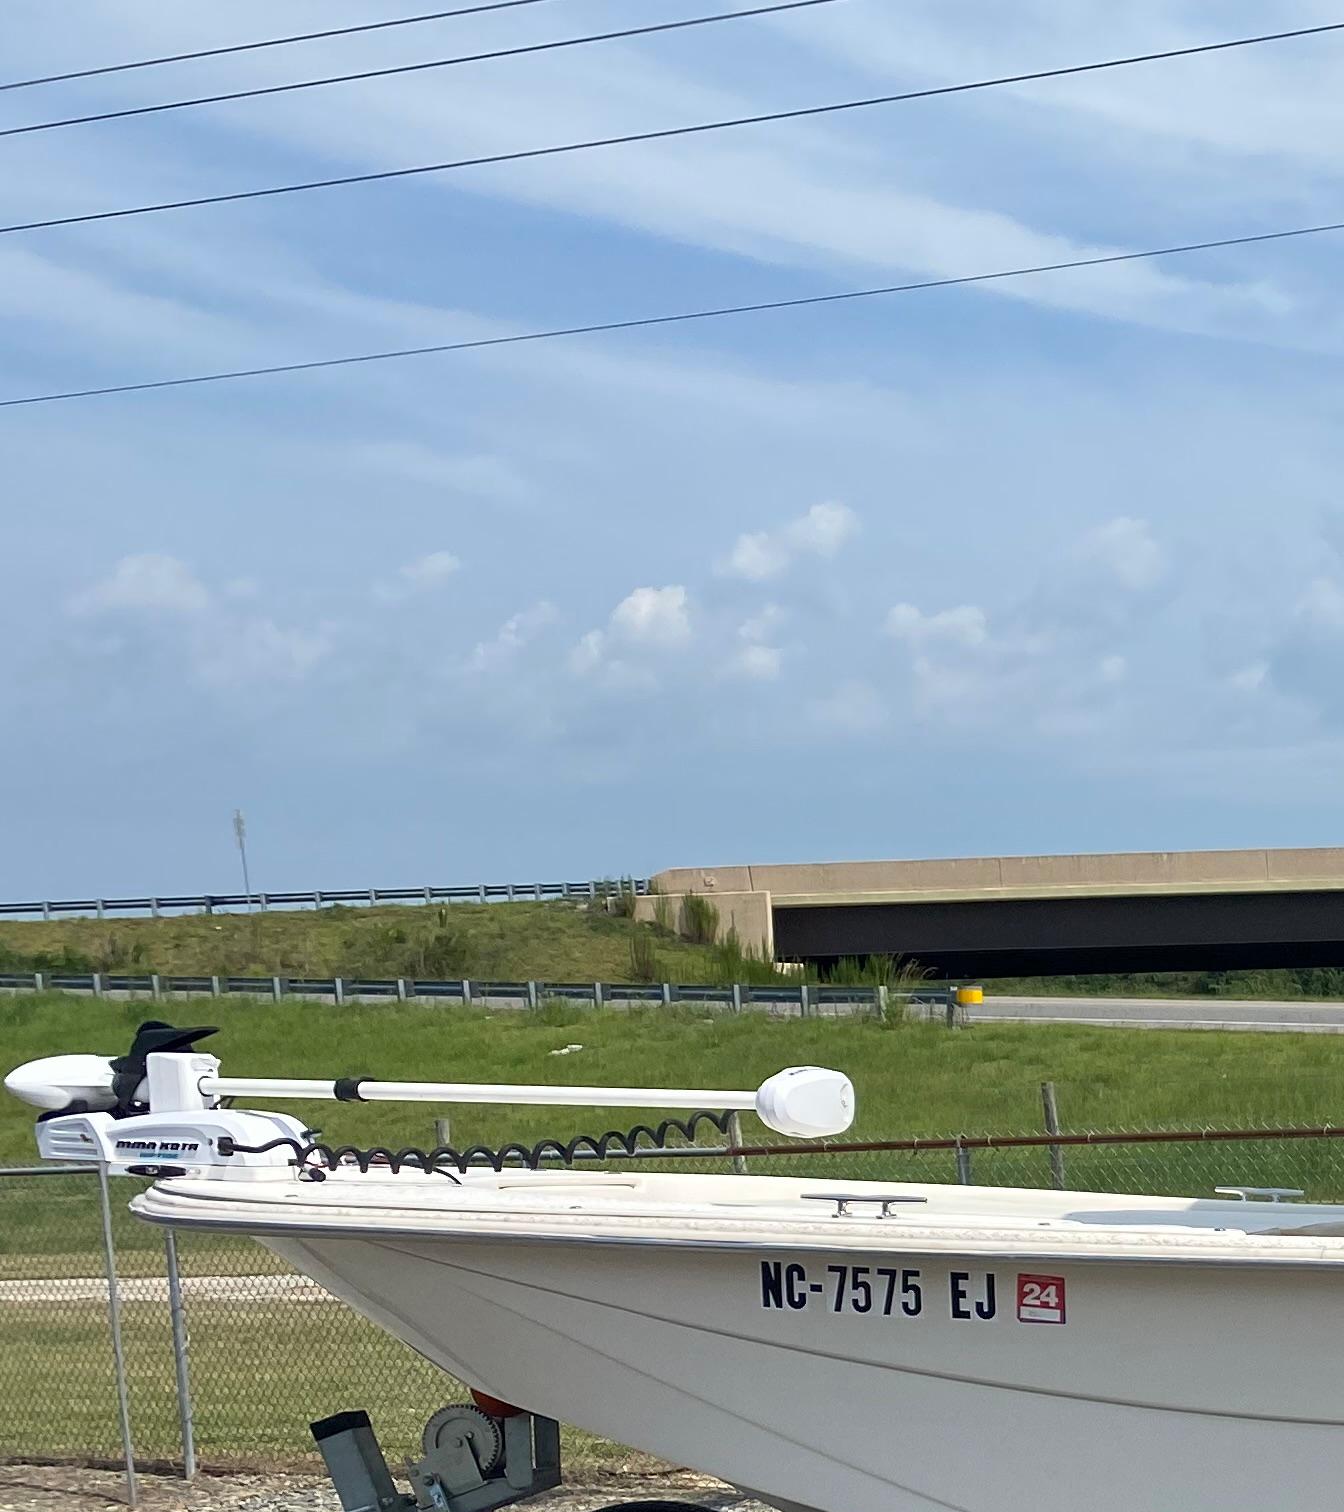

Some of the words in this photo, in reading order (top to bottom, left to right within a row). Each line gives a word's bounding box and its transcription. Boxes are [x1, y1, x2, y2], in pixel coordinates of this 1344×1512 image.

[760, 1261, 923, 1317] NC-7575
[950, 1271, 997, 1321] EJ
[1023, 1282, 1059, 1307] 24
